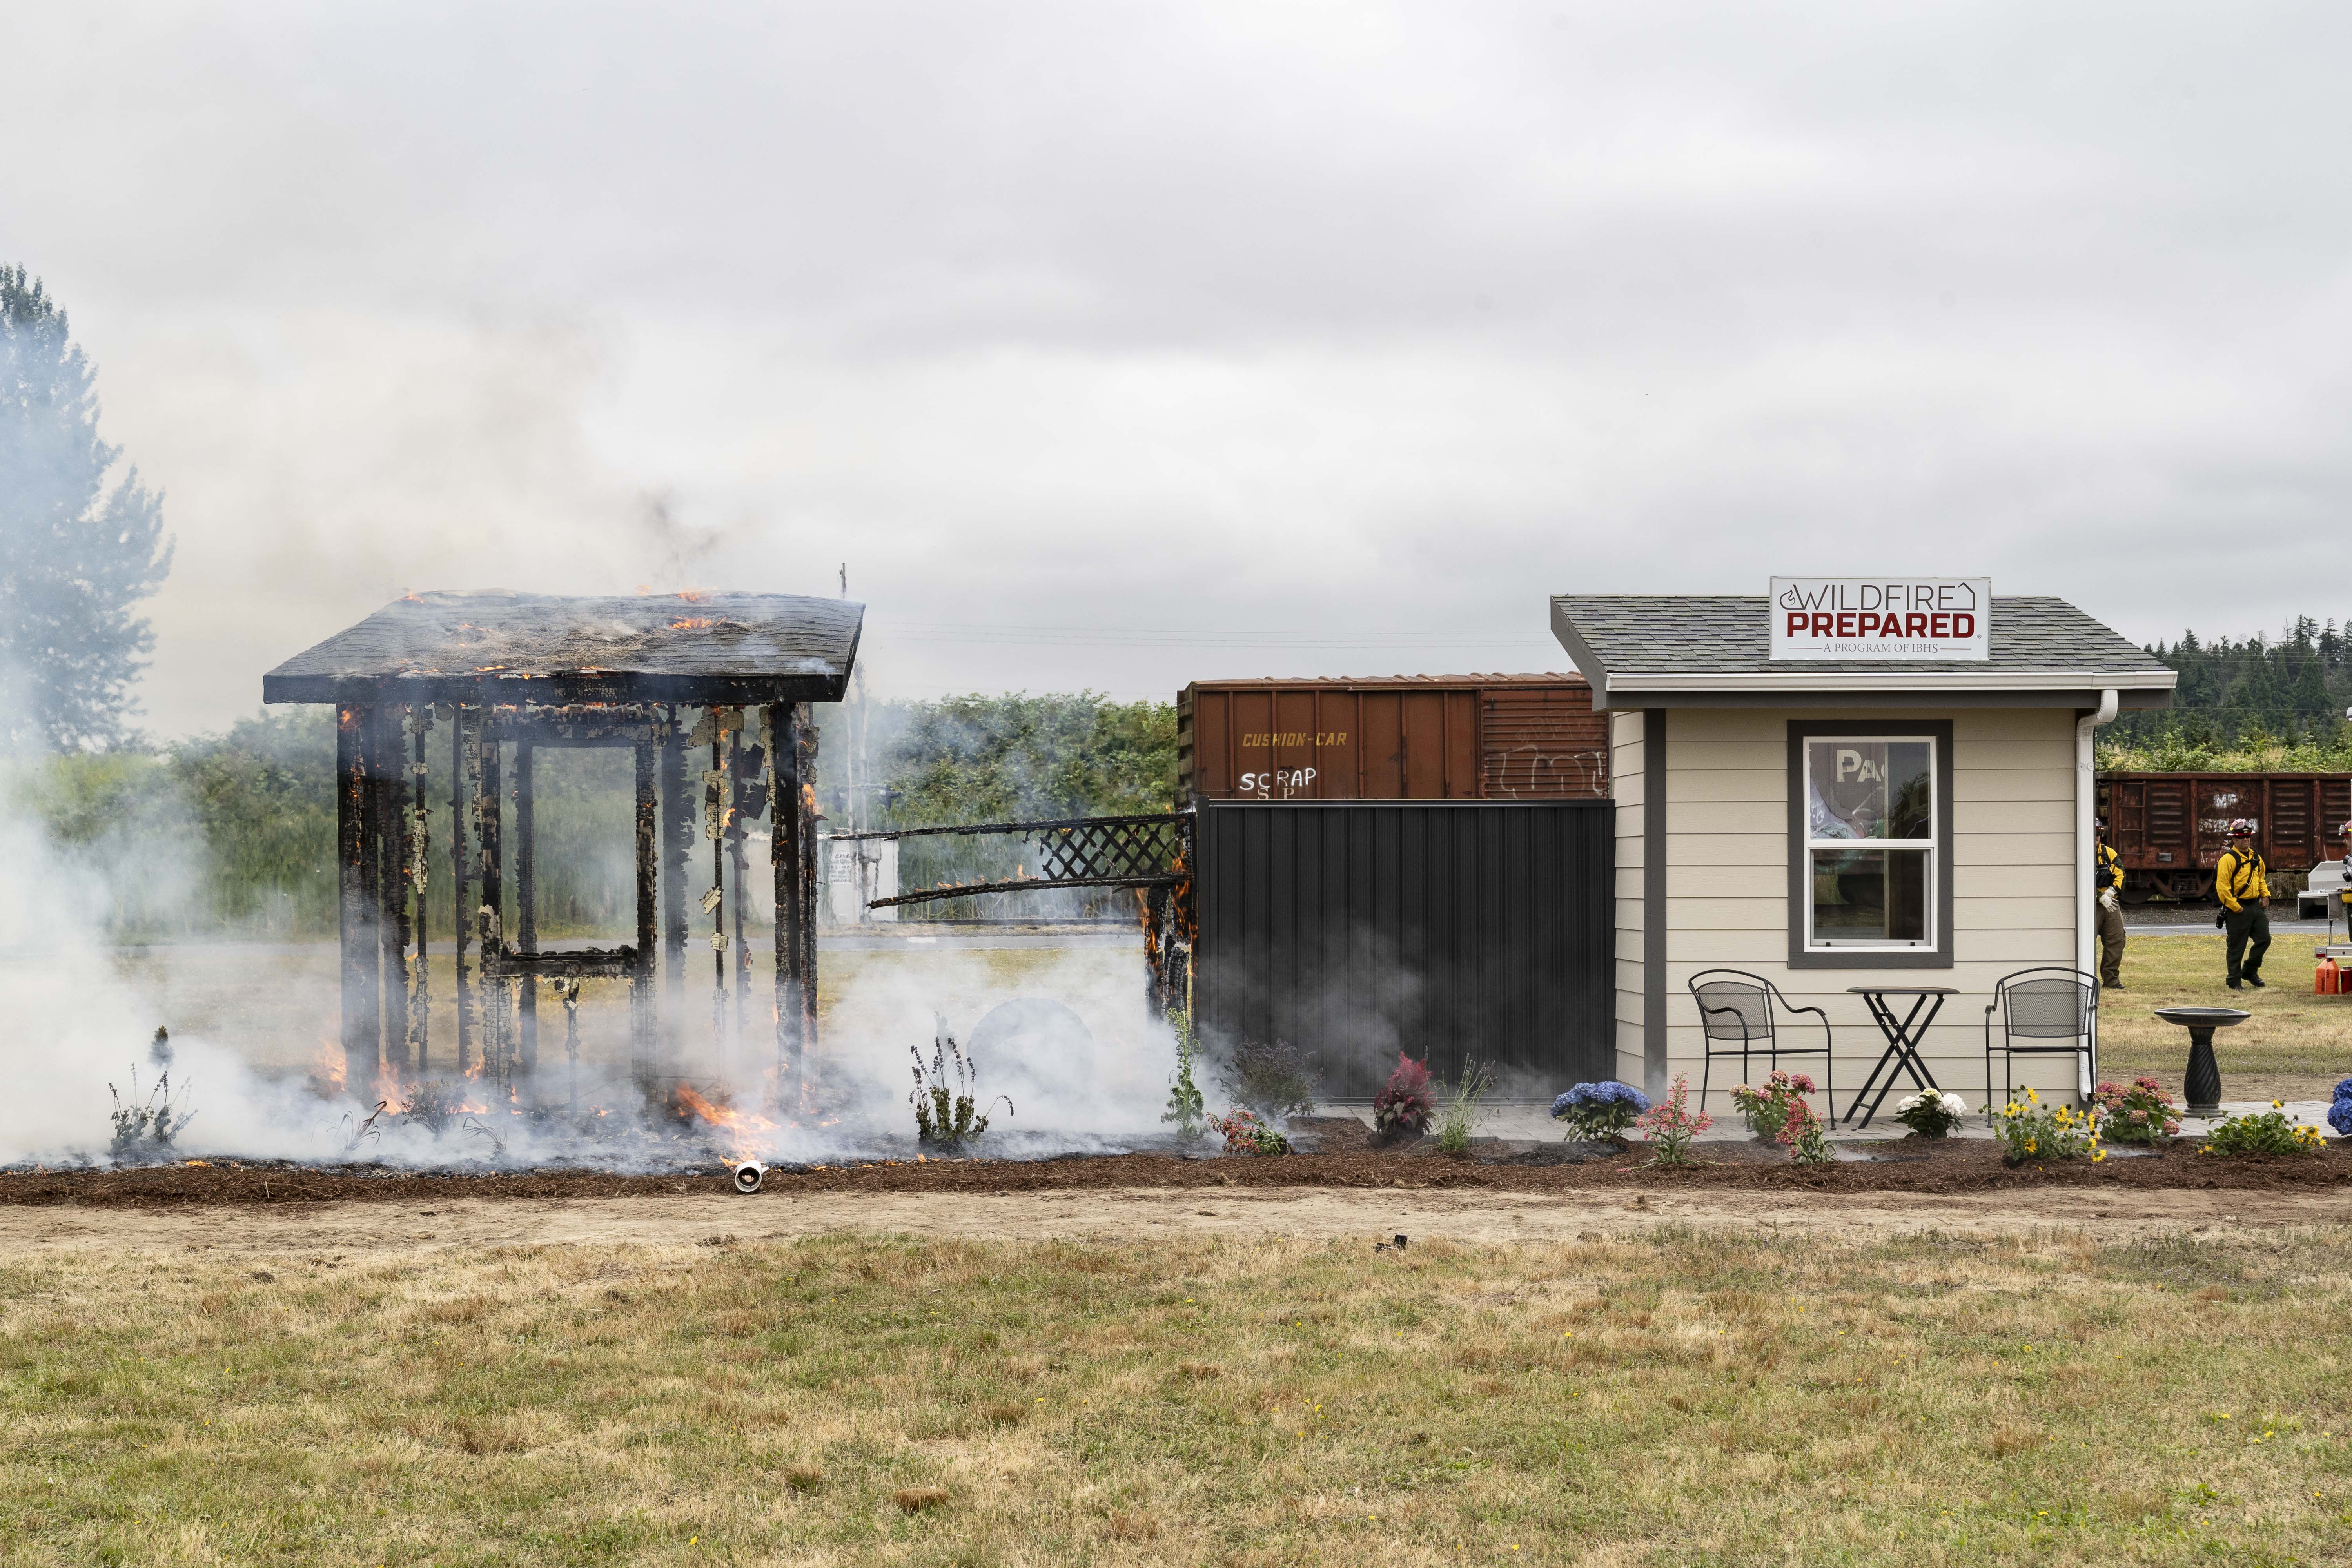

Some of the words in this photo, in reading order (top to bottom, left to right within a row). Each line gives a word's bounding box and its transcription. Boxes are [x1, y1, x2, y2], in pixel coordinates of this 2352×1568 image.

[1793, 584, 1956, 612] WILDFIRE
[1787, 612, 1975, 638] PREPARED
[1823, 643, 1831, 653] A
[1835, 643, 1891, 652] PROGRAM
[1894, 643, 1909, 652] OF
[1912, 644, 1938, 653] IBHS
[1239, 767, 1316, 791] SCRAP
[1836, 750, 1884, 783] PA
